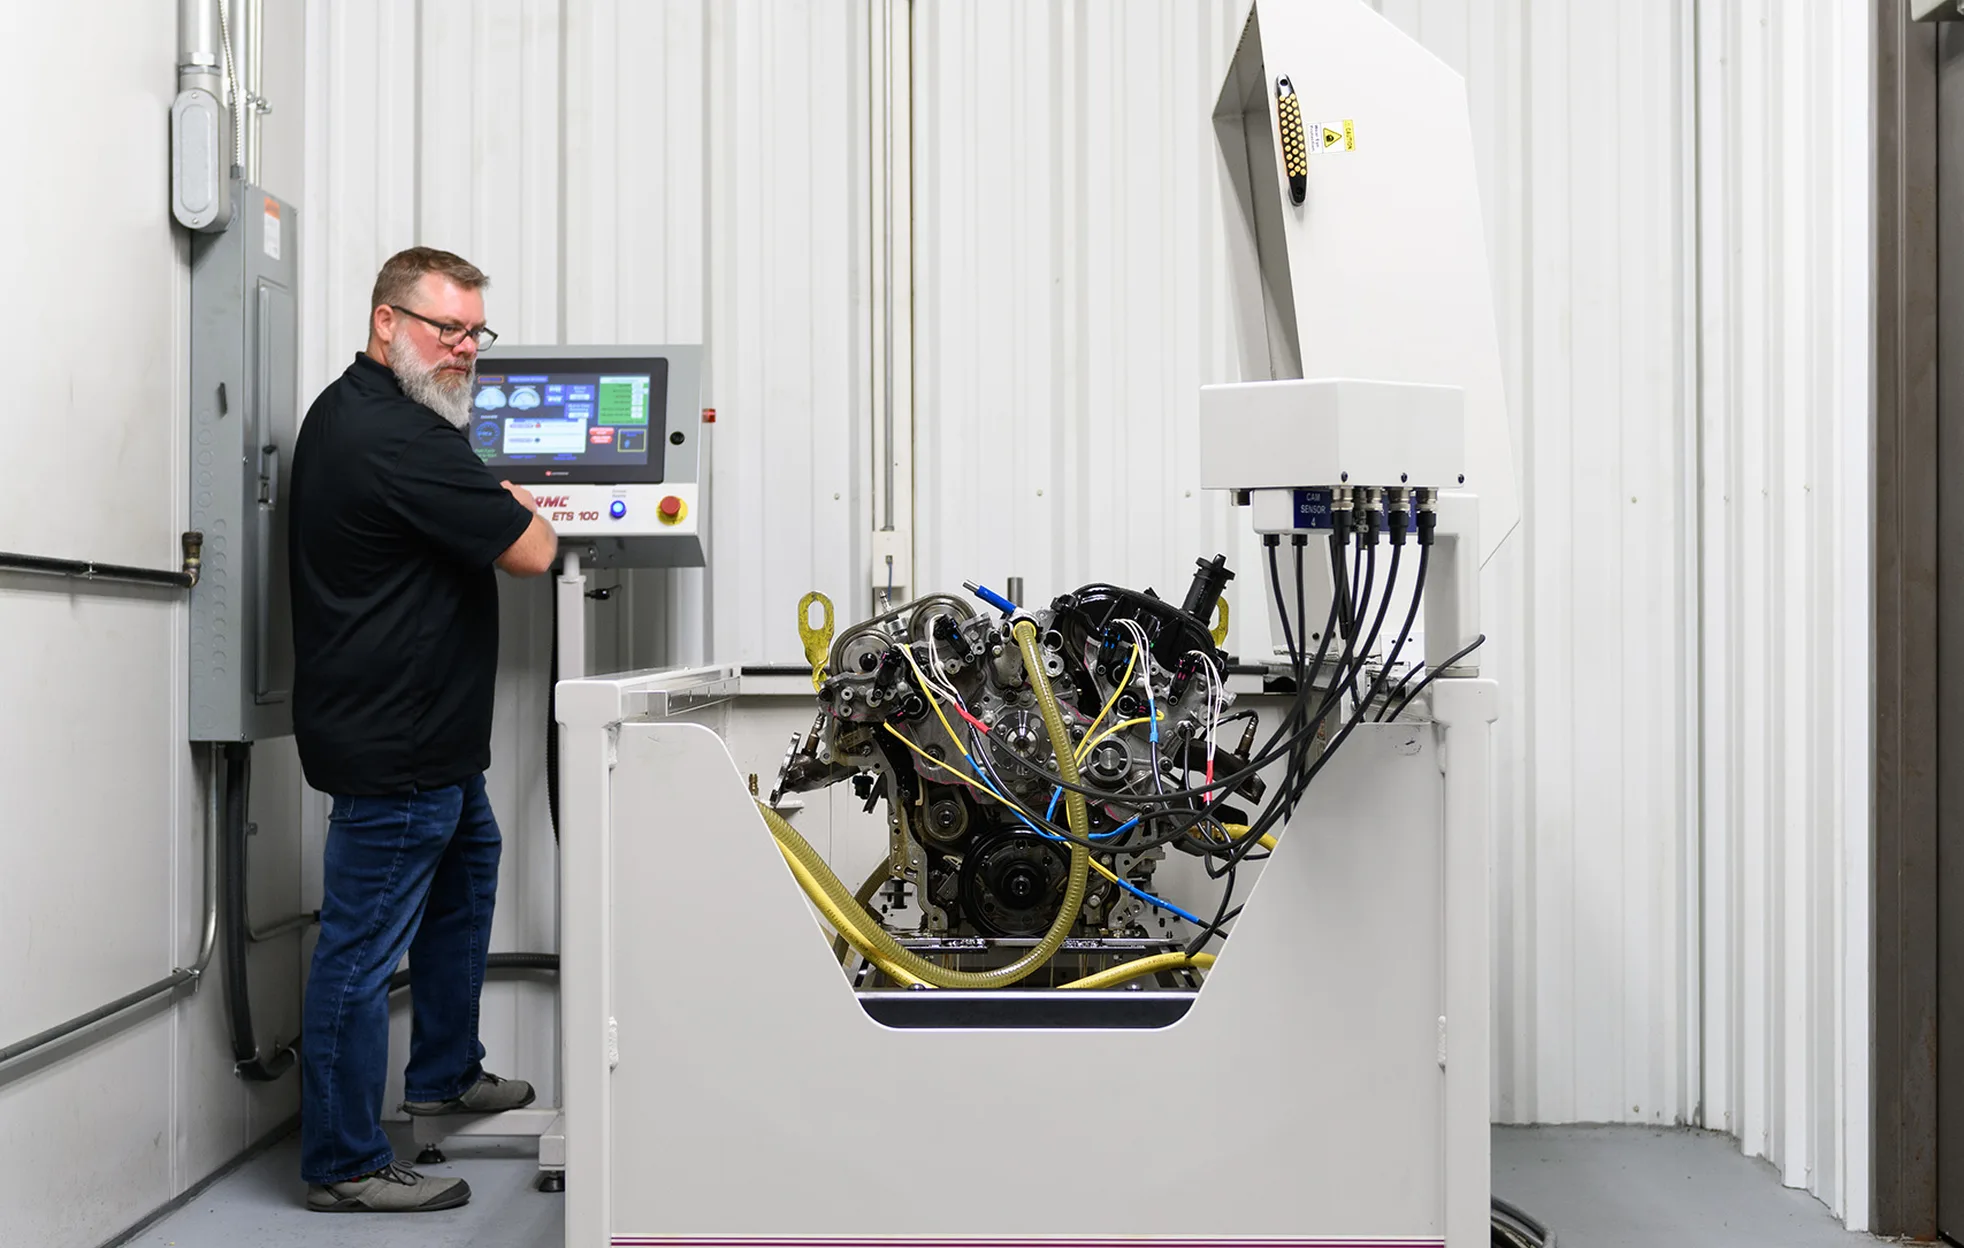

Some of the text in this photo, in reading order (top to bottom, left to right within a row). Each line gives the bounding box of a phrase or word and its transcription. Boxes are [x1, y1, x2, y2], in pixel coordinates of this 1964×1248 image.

[1306, 492, 1321, 501] CAM
[535, 496, 570, 508] RMC
[1300, 504, 1326, 514] SENSOR
[552, 511, 599, 521] ETS 100
[1311, 517, 1316, 527] 4
